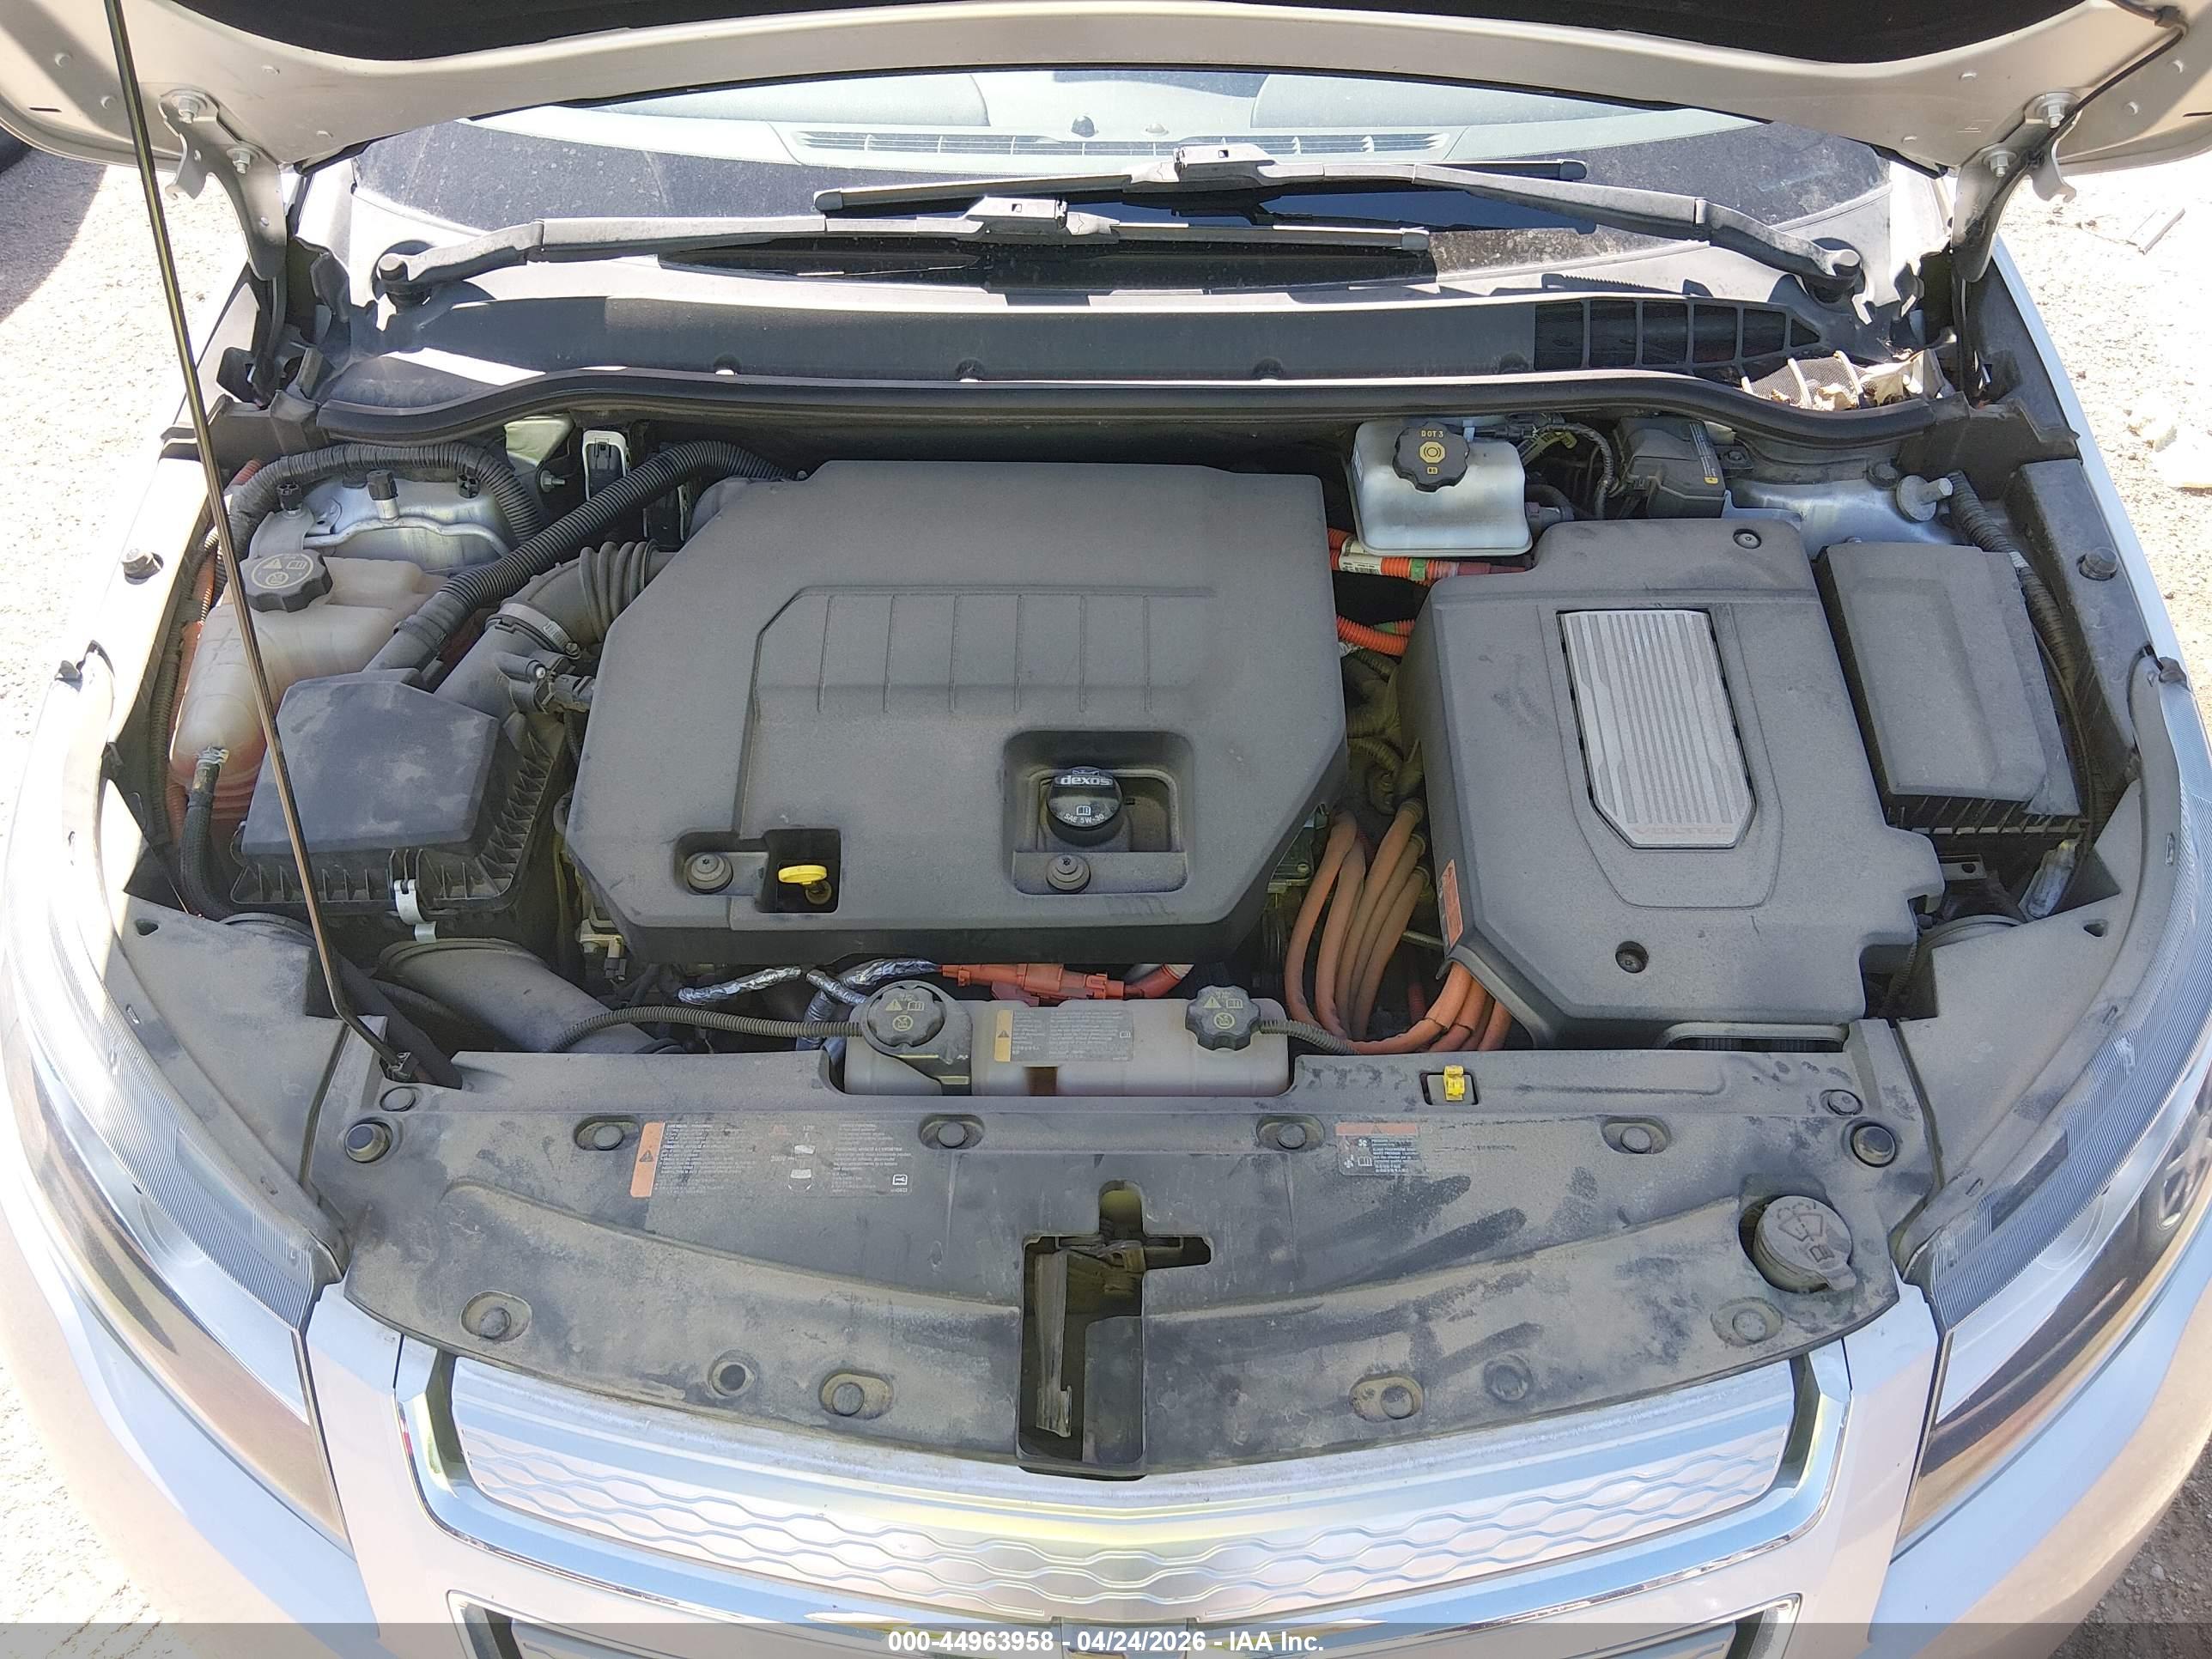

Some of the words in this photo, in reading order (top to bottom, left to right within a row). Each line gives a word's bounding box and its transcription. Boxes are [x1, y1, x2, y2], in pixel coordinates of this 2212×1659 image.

[1060, 775, 1113, 786] dexos
[1064, 813, 1078, 823] SAE
[1080, 813, 1104, 823] 5W-30
